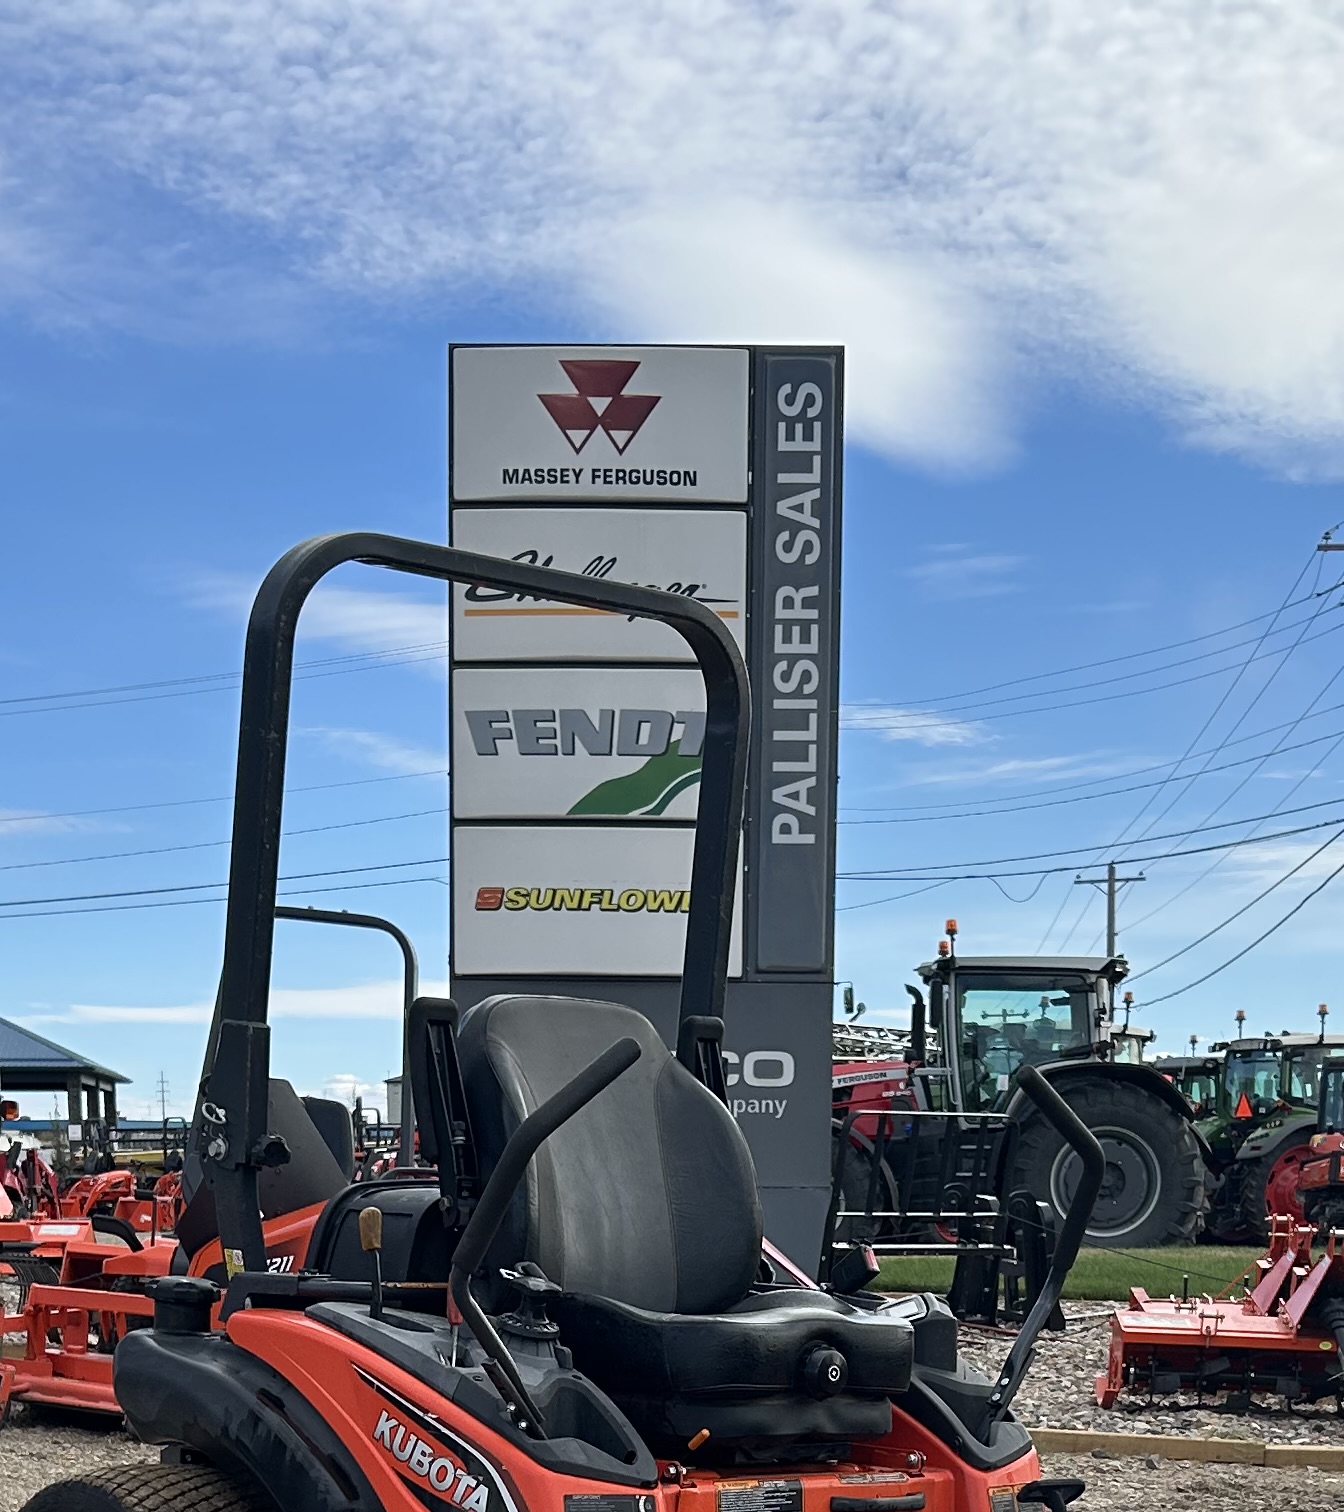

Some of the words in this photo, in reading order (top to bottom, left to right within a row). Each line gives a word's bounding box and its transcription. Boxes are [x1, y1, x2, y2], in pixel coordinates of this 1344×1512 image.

[502, 467, 584, 486] MASSEY
[591, 468, 697, 487] FERGUSON
[775, 381, 824, 566] SALES
[770, 585, 820, 845] PALLISER
[837, 1071, 887, 1085] FERGUSON
